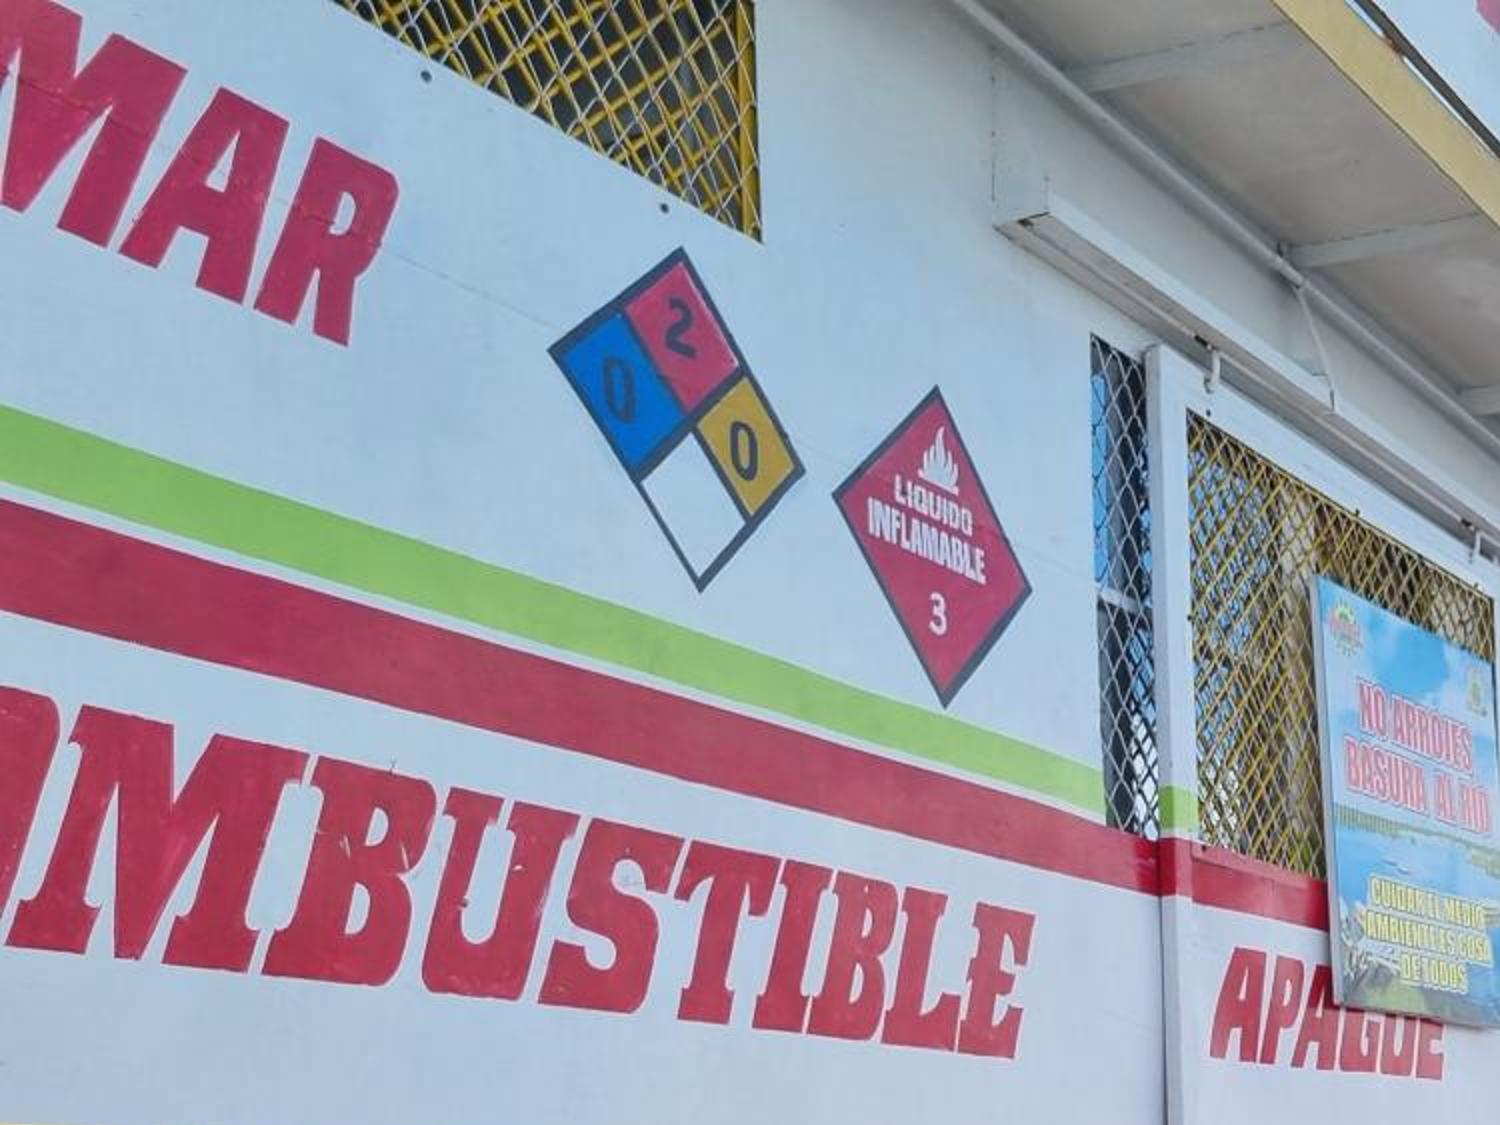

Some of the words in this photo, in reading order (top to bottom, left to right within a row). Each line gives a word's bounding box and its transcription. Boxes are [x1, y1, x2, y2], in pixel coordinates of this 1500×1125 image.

[0, 0, 400, 347] MAR
[664, 297, 696, 358] 2
[603, 356, 634, 423] 0
[729, 420, 758, 481] 0
[867, 496, 987, 586] INFLAMABLE
[929, 591, 947, 636] 3
[1358, 679, 1387, 736] NO
[1344, 736, 1426, 815] BASURA
[1400, 952, 1421, 981] DE
[1209, 947, 1445, 1080] APAGUE
